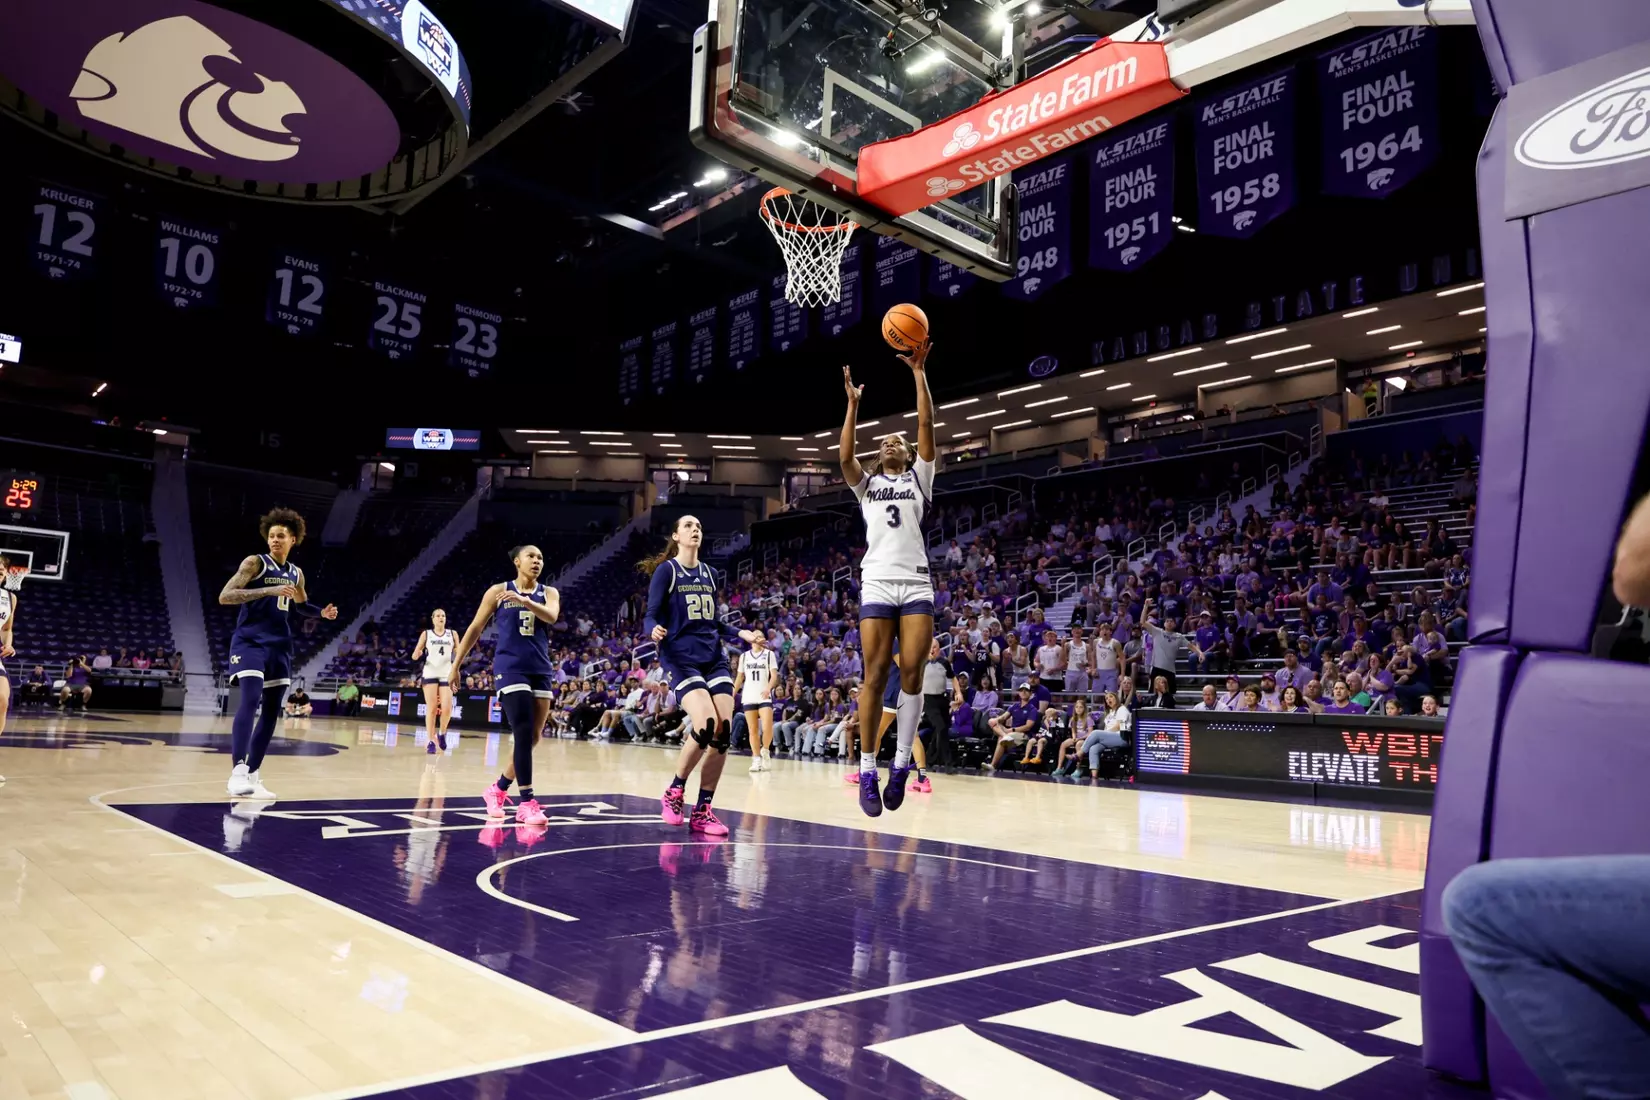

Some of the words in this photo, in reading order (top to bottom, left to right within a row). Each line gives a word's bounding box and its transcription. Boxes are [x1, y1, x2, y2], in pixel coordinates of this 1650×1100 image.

[1328, 25, 1427, 74] K-STATE
[1334, 64, 1361, 79] MEN'S
[1363, 40, 1421, 68] BASKETBALL
[1201, 75, 1287, 122] K-STATE
[1341, 69, 1415, 111] FINAL
[1207, 113, 1231, 127] MEN'S
[1231, 94, 1280, 118] BASKETBALL
[1341, 89, 1414, 131] FOUR
[1095, 122, 1168, 164] K-STATE
[1100, 159, 1120, 169] MEN'S
[1120, 139, 1162, 161] BASKETBALL
[1213, 120, 1275, 157] FINAL
[1340, 124, 1423, 174] 1964
[1213, 139, 1274, 175] FOUR
[1018, 163, 1067, 194] STATE
[1105, 163, 1157, 197] FINAL
[1210, 172, 1280, 215] 1958
[40, 186, 95, 211] KRUGER
[1105, 181, 1156, 214] FOUR
[33, 203, 96, 257] 12
[1017, 217, 1055, 242] OUR
[1018, 201, 1056, 227] INAL
[160, 220, 219, 245] WILLIAMS
[1104, 211, 1159, 250] 1951
[35, 251, 81, 270] 1971-74
[160, 236, 215, 285] 10
[284, 255, 319, 273] EVANS
[1017, 246, 1058, 278] 948
[163, 282, 203, 299] 1972-76
[275, 268, 324, 316] 12
[374, 281, 428, 304] BLACKMAN
[373, 295, 422, 339] 25
[454, 303, 502, 324] RICHMOND
[1090, 311, 1219, 366] KANSAS
[1244, 273, 1365, 330] STATE
[454, 317, 498, 359] 23
[6, 488, 31, 509] 25
[12, 479, 37, 491] 6:29
[867, 487, 916, 503] Wildcats
[886, 504, 901, 528] 3
[685, 593, 715, 620] 20
[519, 610, 535, 636] 3
[438, 646, 444, 656] 4
[977, 651, 987, 662] 24
[751, 670, 760, 681] 11
[1288, 751, 1380, 783] ELEVATE
